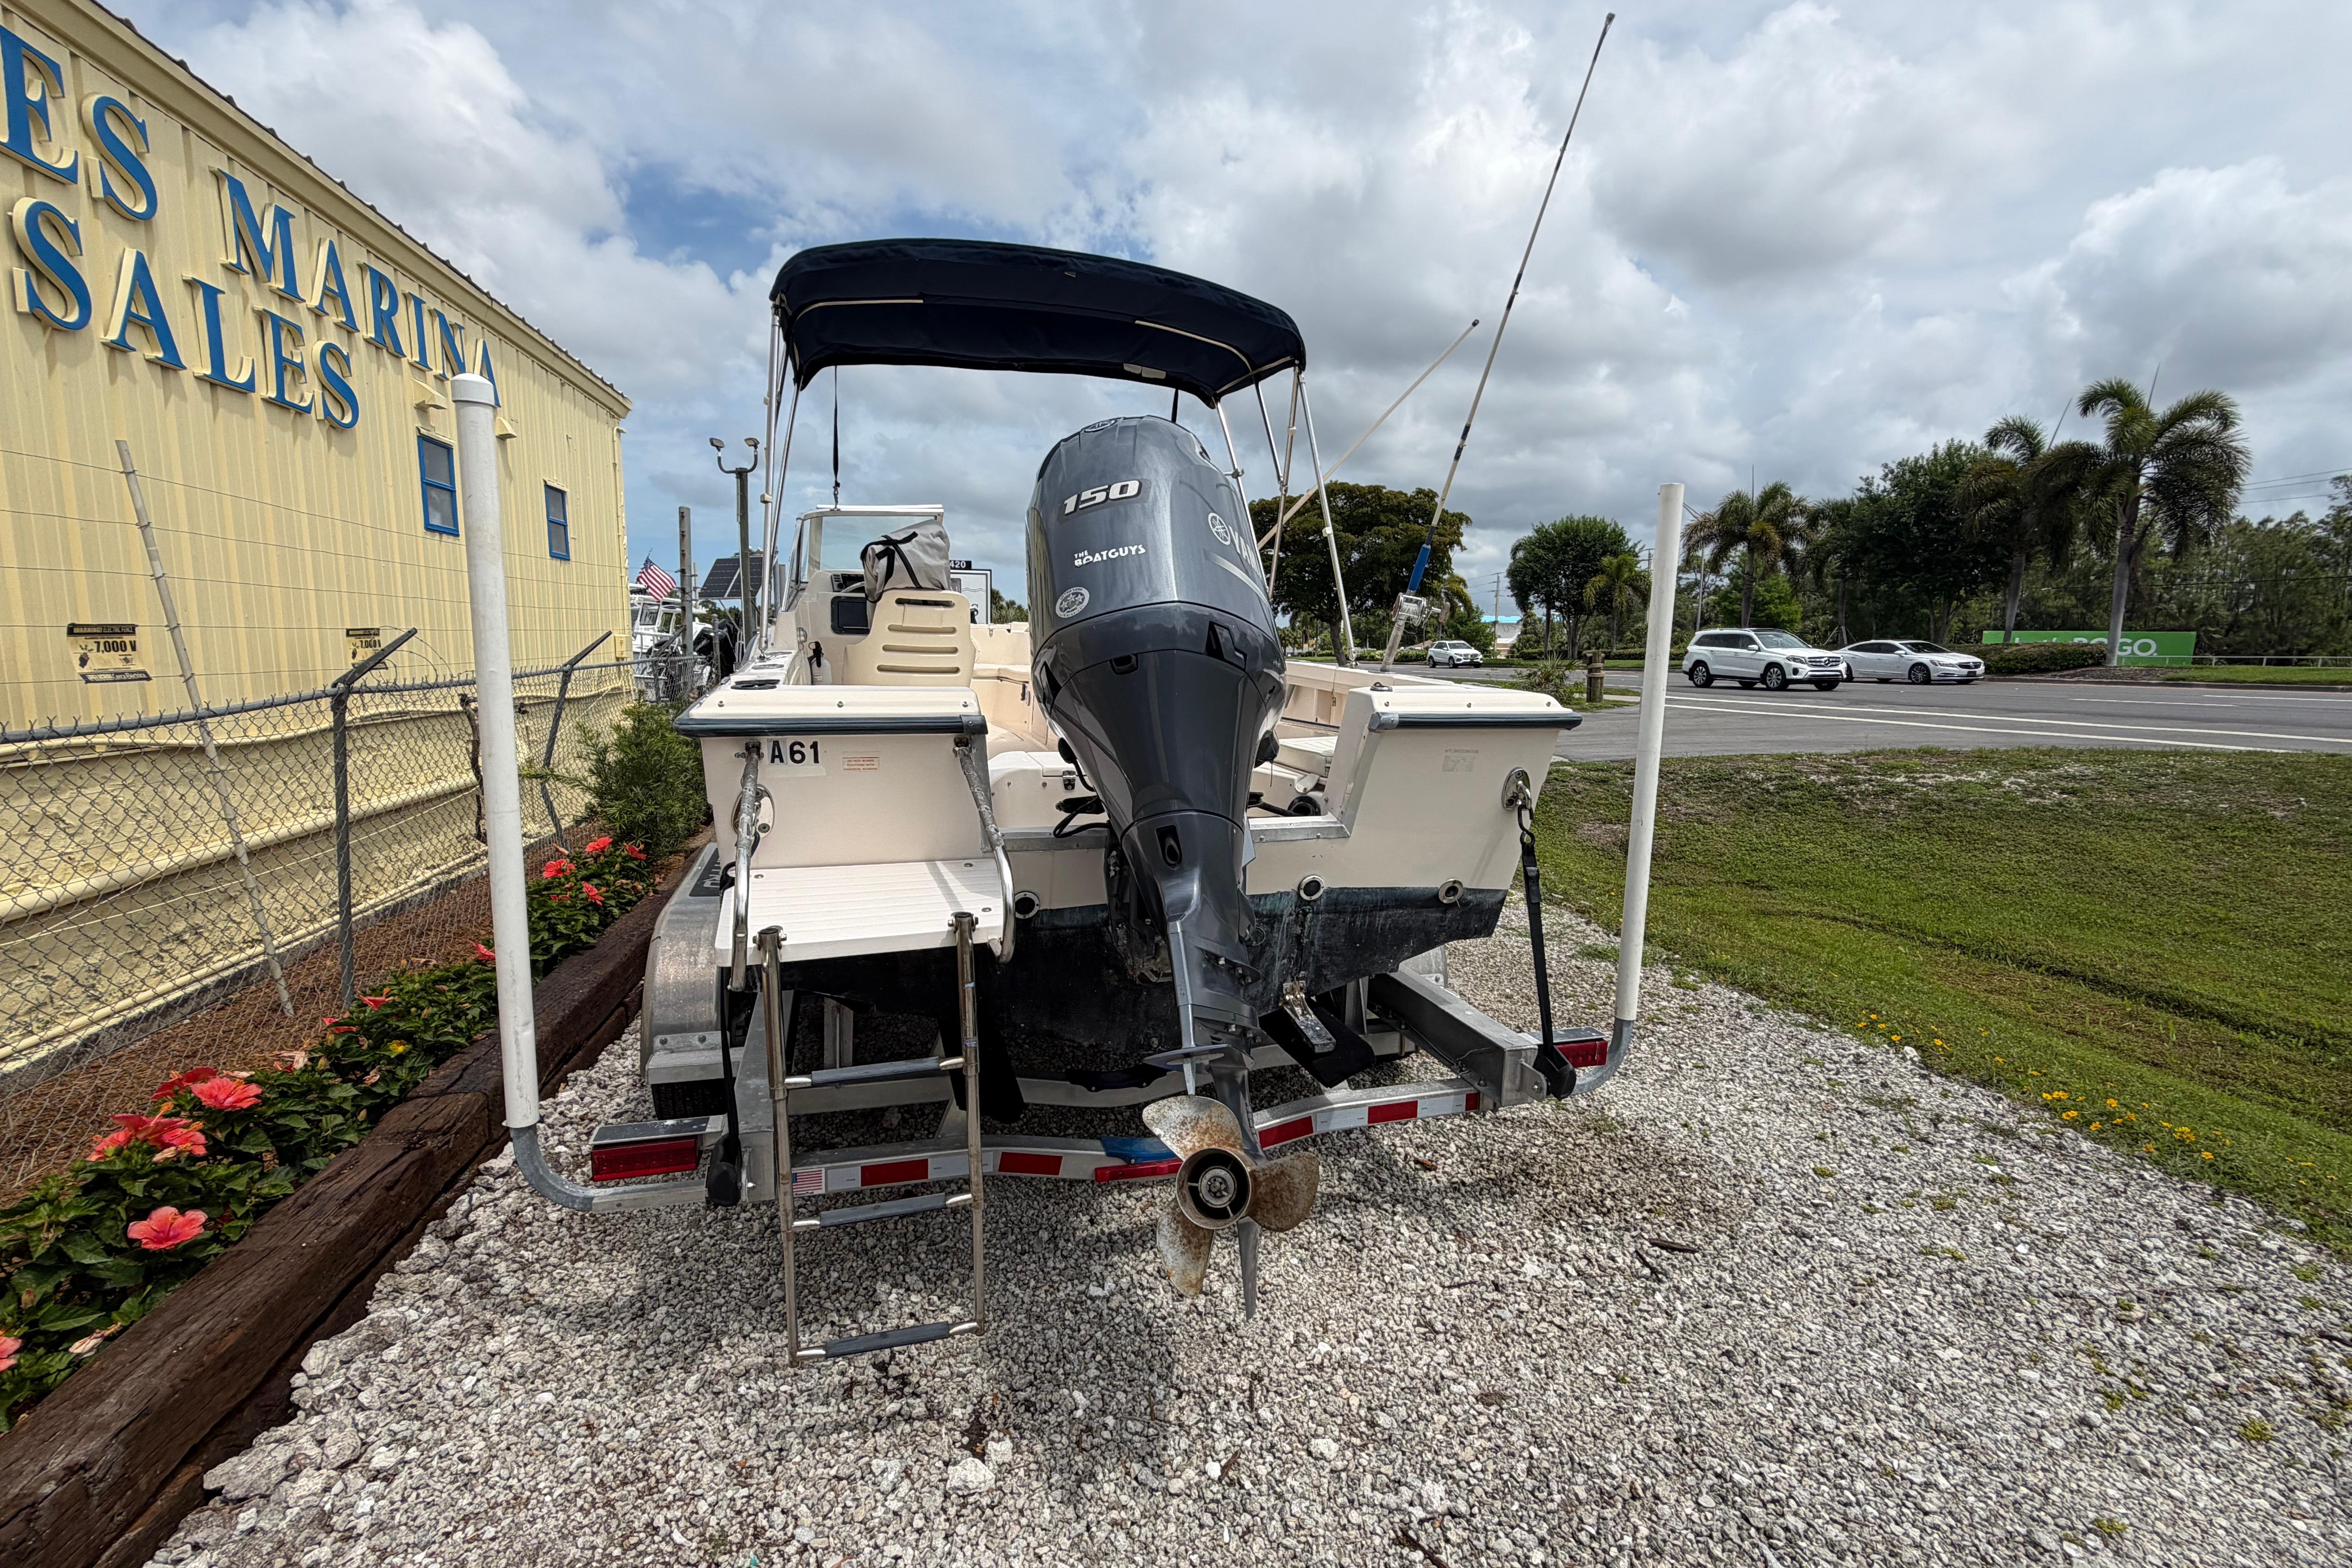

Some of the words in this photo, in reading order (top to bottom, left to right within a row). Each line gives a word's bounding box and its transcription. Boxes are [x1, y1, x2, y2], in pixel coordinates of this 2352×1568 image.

[0, 25, 158, 221] ES
[215, 167, 502, 408] MARINA
[16, 198, 359, 430] SALES
[1064, 480, 1141, 516] 150
[1074, 550, 1088, 558] THE
[1074, 544, 1146, 567] BOATGUYS
[94, 640, 127, 653] 7,000
[129, 640, 137, 651] V
[359, 639, 377, 649] 7,000
[770, 740, 820, 764] A61
